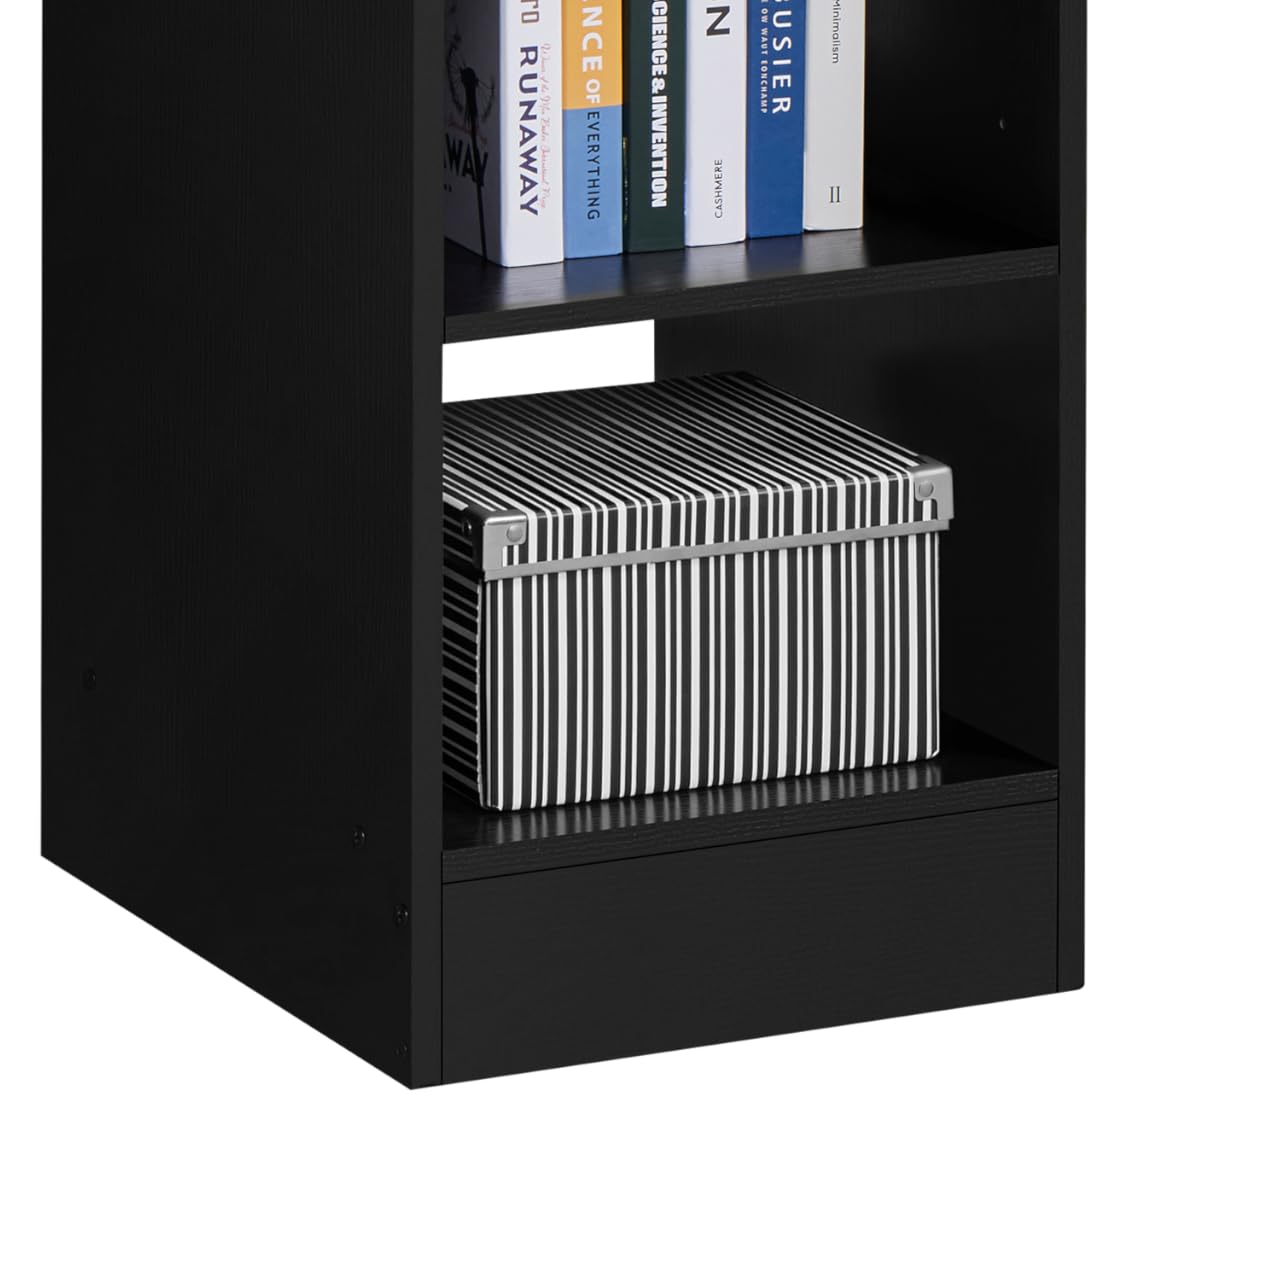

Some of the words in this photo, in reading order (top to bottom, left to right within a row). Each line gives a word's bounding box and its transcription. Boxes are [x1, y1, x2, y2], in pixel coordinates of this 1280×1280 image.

[518, 45, 539, 216] RUNAWAY
[585, 79, 601, 104] OF
[587, 111, 601, 220] EVERYTHING
[651, 96, 668, 208] INVENTION
[715, 159, 723, 218] CASHMERE
